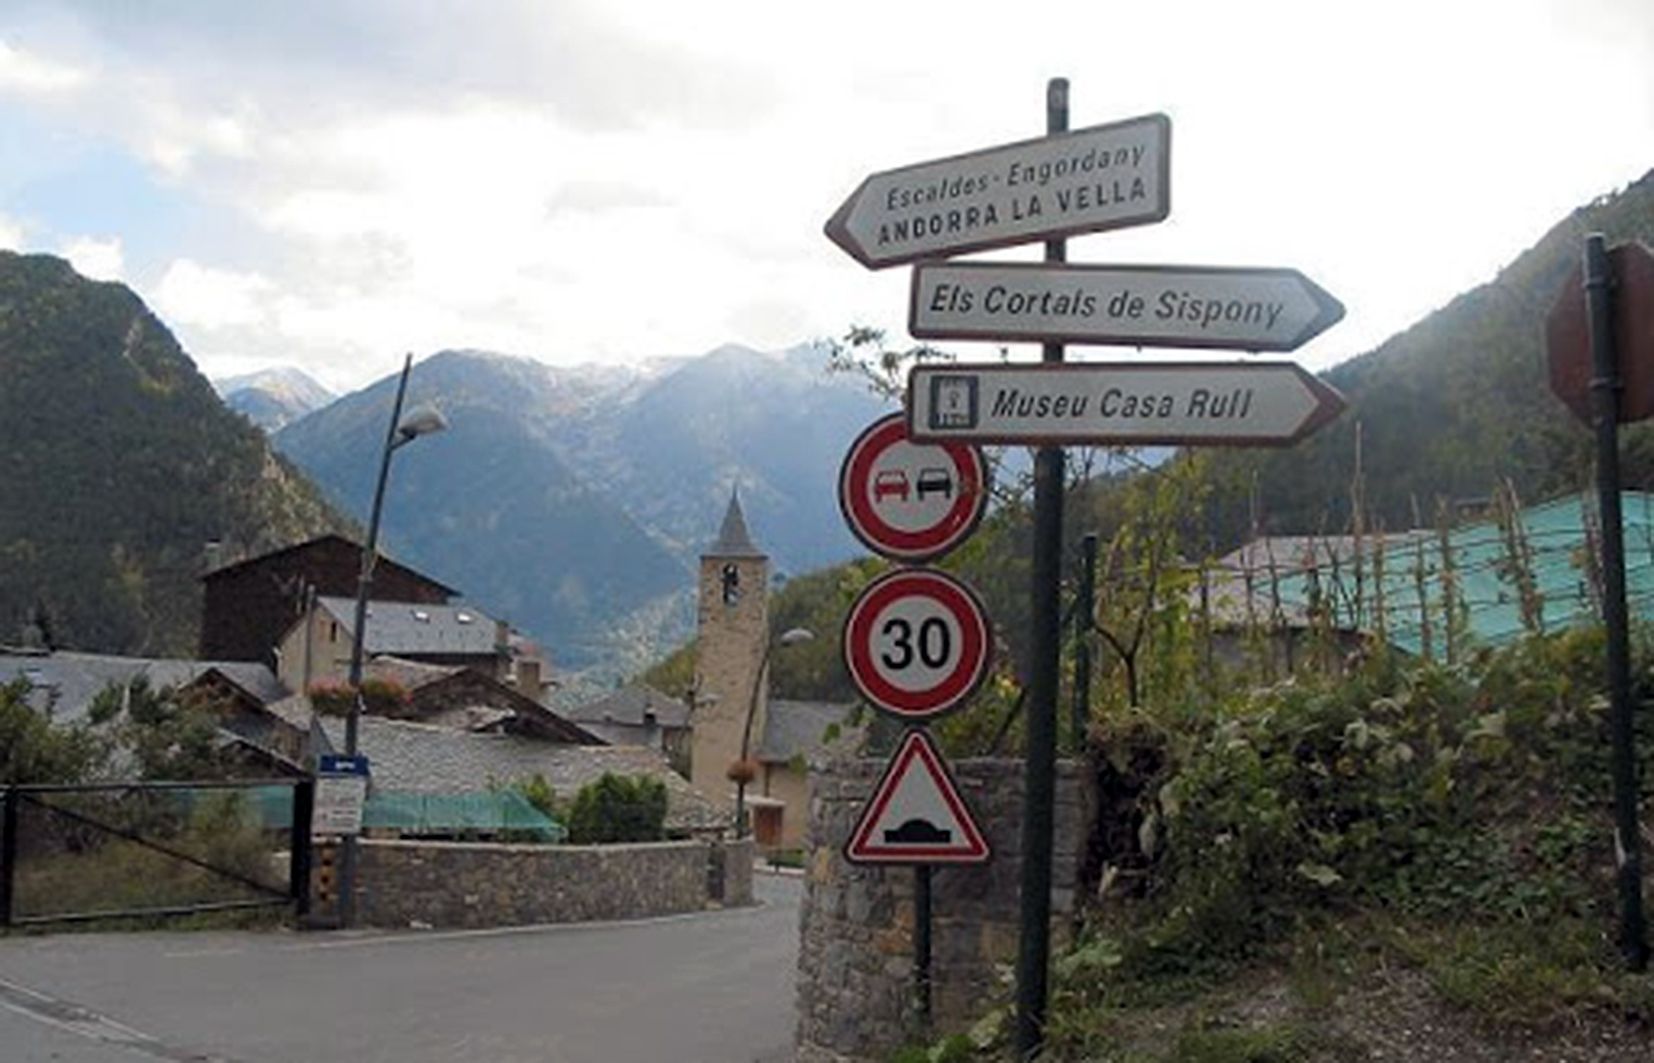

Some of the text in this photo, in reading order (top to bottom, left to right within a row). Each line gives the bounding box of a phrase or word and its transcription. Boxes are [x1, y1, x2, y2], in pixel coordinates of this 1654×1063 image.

[877, 177, 1146, 246] ANDORRA LA VELLA
[930, 284, 1284, 329] Els Cortals de Sispony
[990, 388, 1256, 419] Museu Casa Rull
[881, 617, 951, 670] 30
